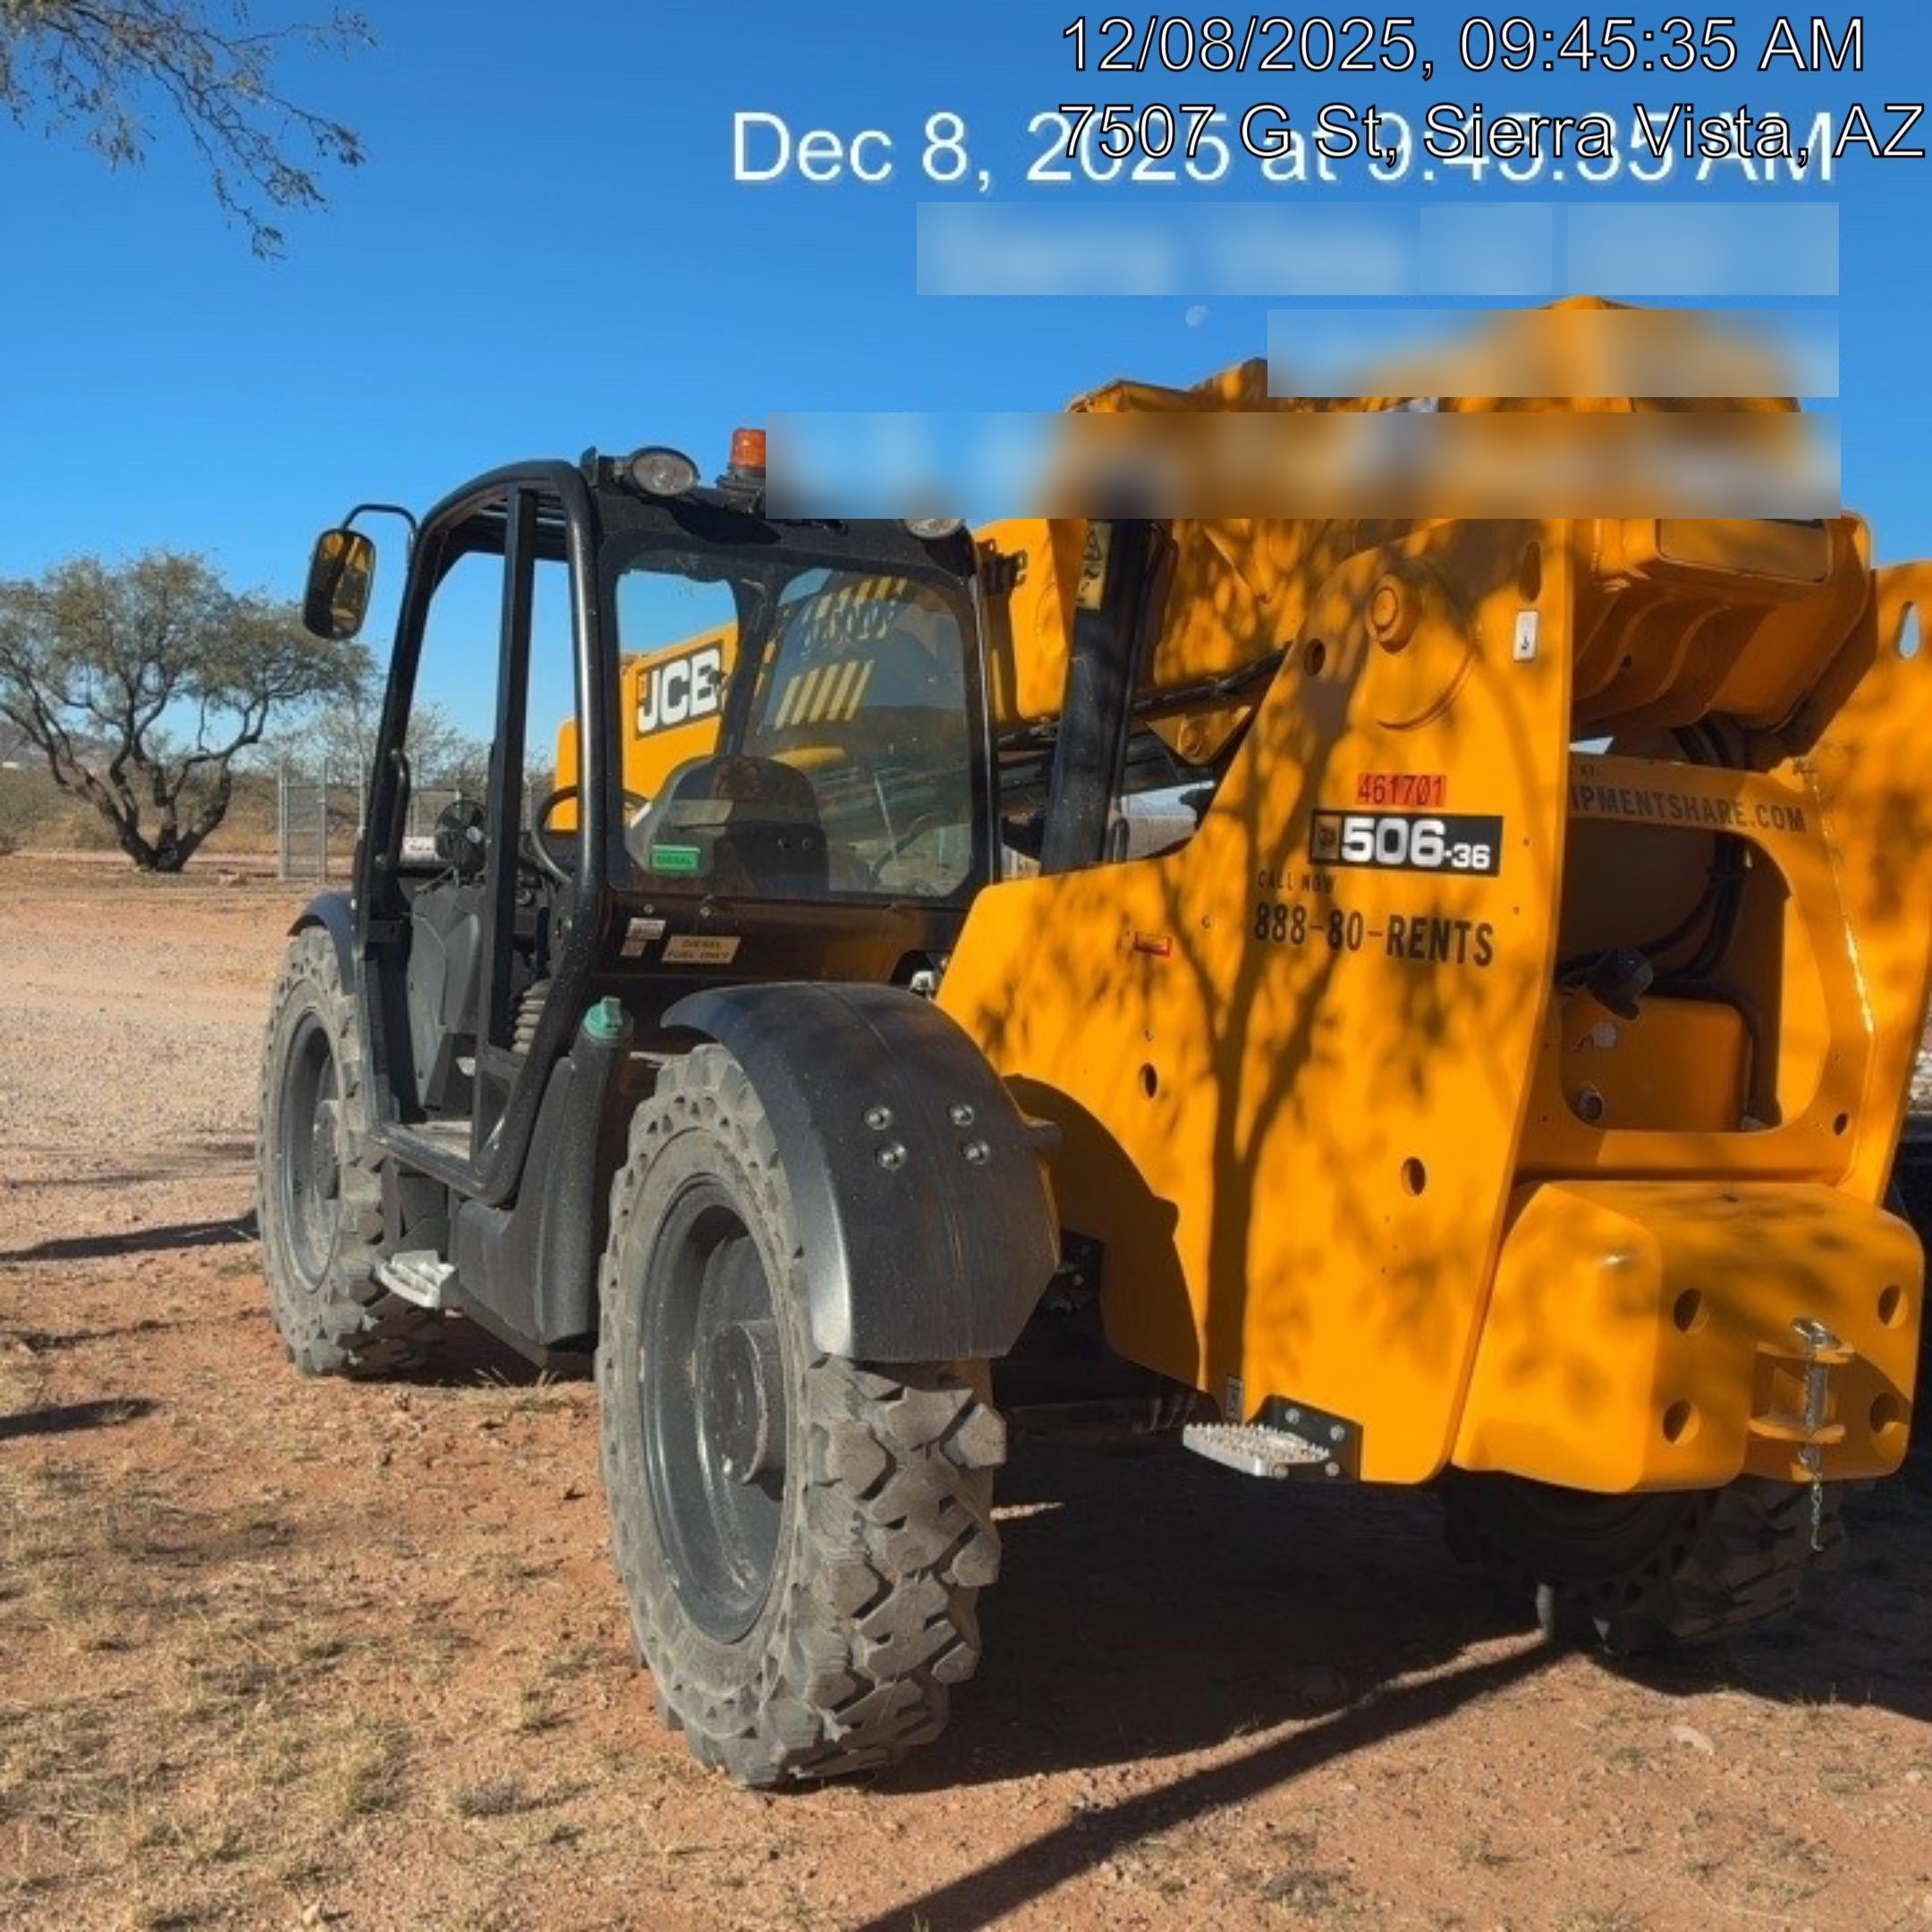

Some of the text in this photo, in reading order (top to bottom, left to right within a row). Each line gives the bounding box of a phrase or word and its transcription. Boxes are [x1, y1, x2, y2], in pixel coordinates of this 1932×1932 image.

[638, 648, 720, 733] JCB
[1358, 774, 1445, 806] 461701
[1257, 869, 1337, 895] CALL NOW
[1254, 901, 1494, 967] 888-80-RENTS
